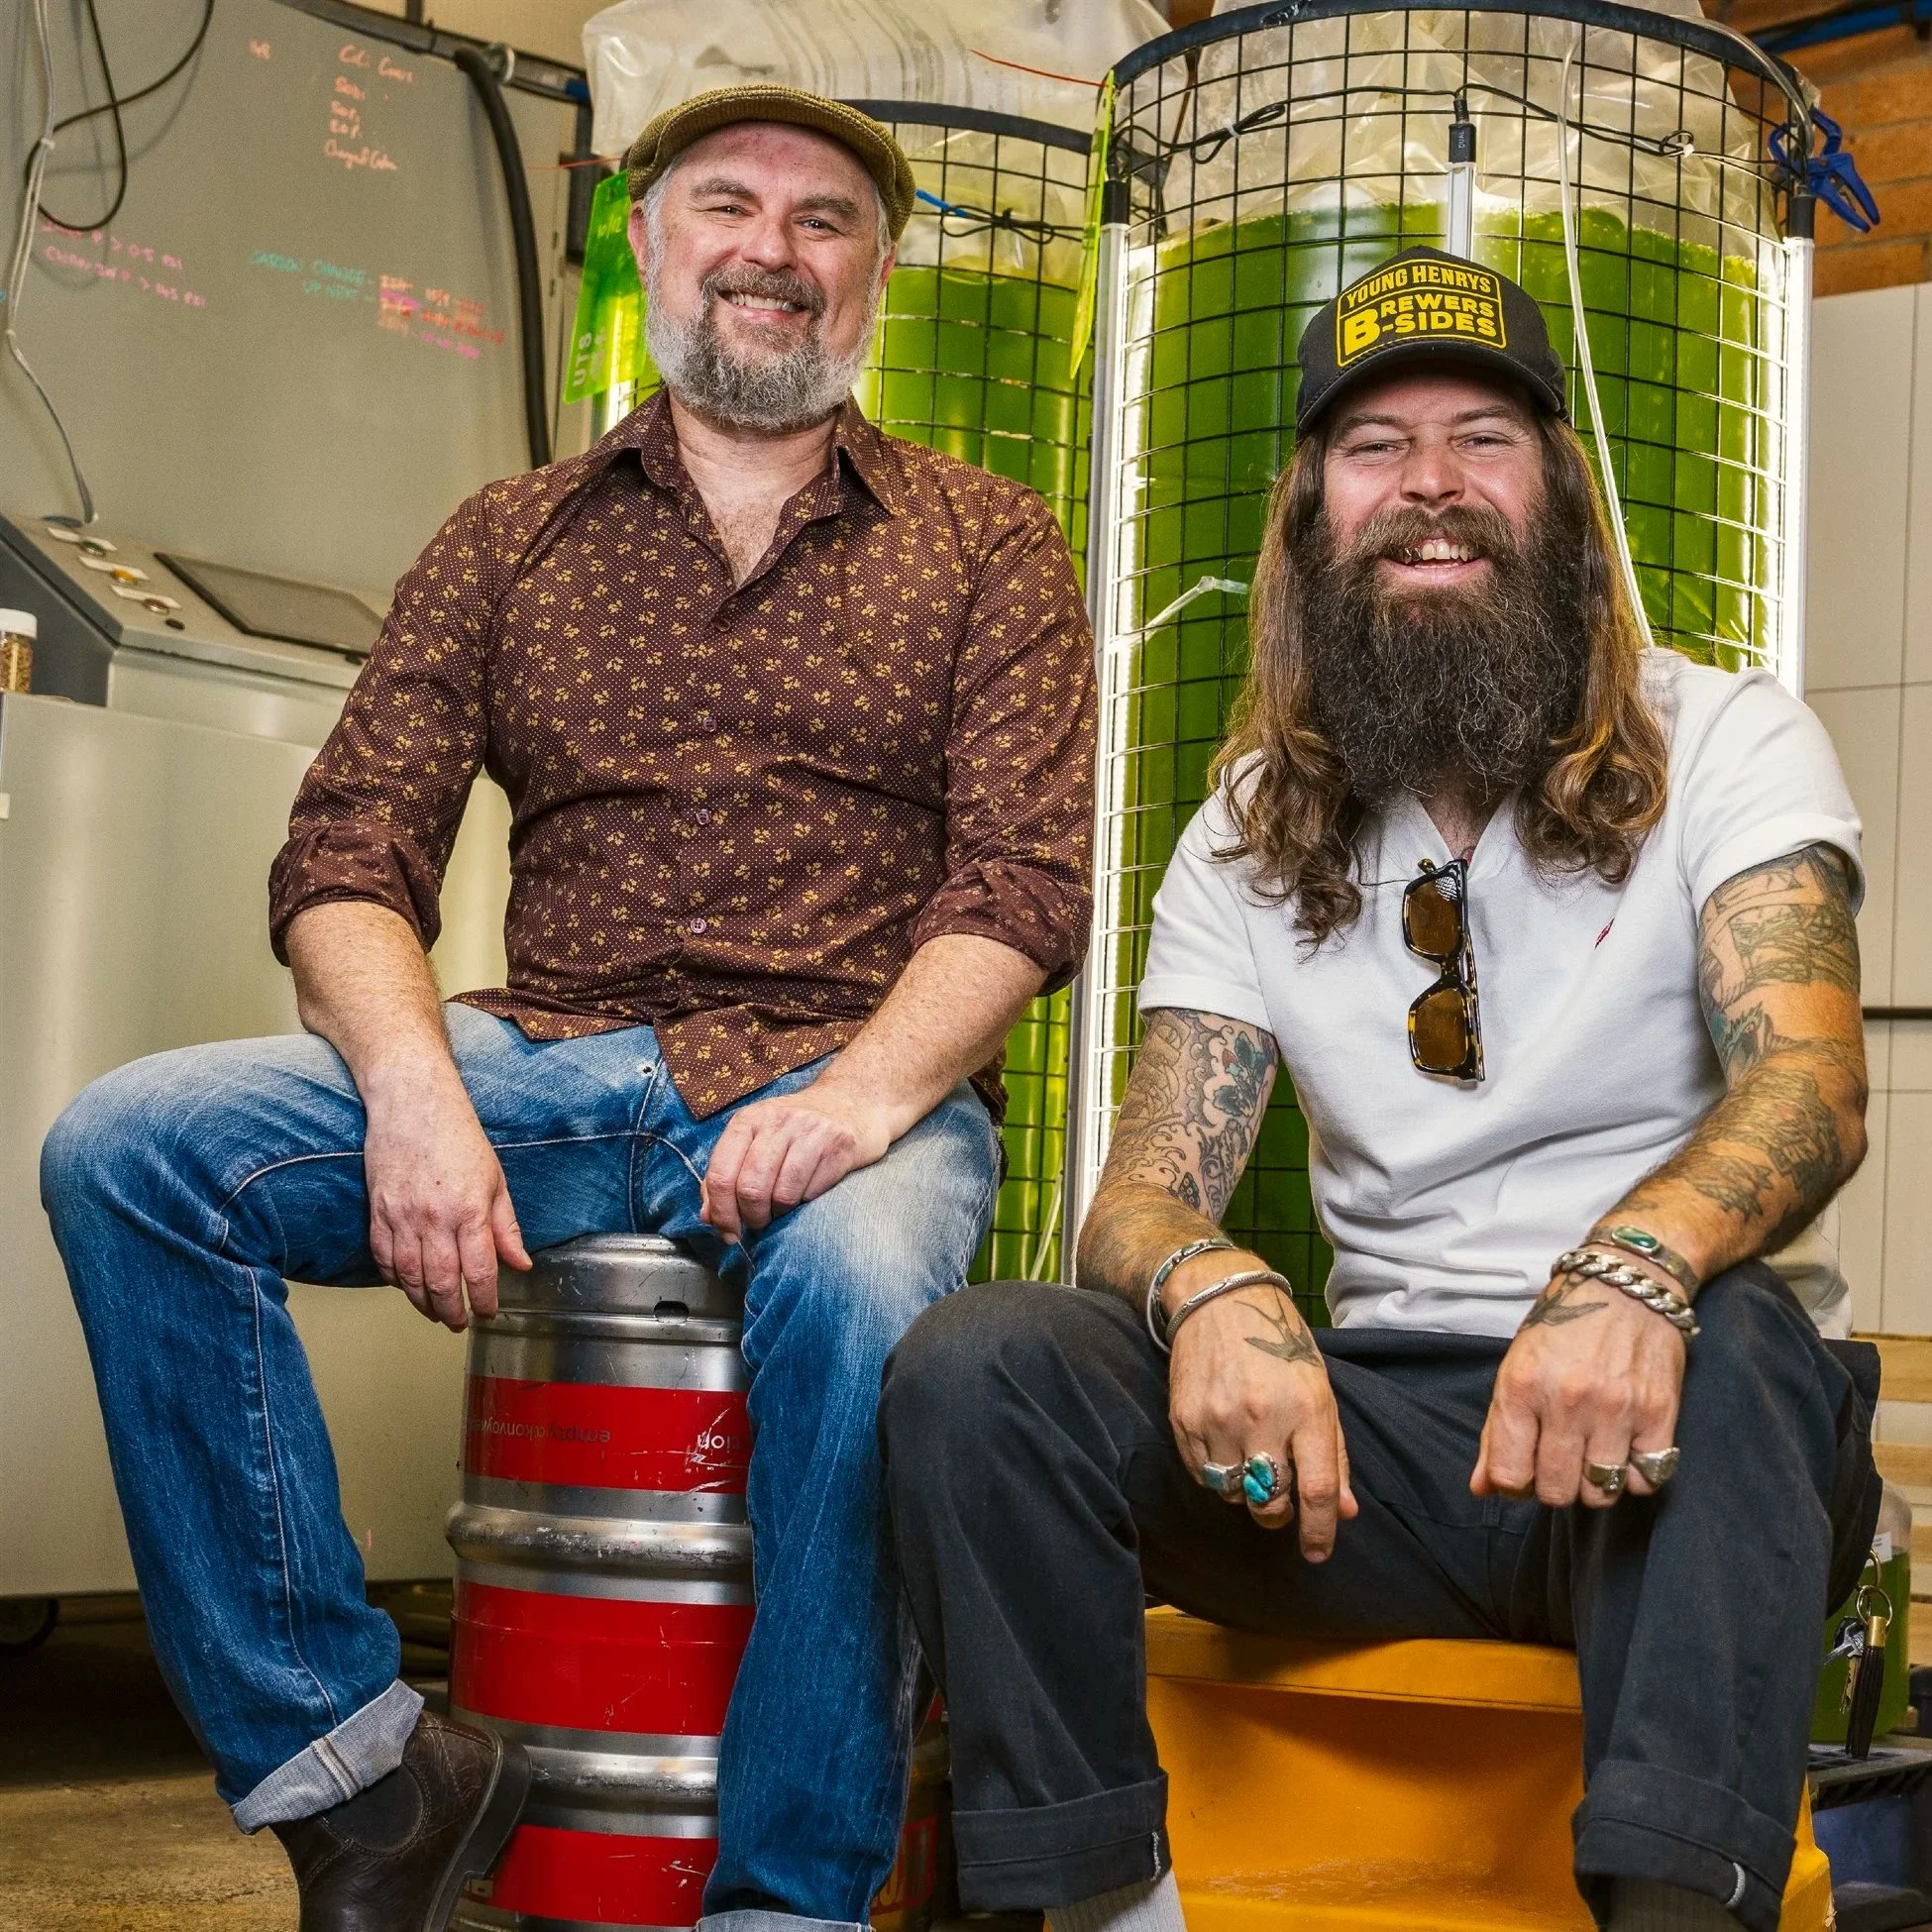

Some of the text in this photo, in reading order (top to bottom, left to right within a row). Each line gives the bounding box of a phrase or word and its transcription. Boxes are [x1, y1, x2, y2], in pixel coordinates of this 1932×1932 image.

[1346, 266, 1491, 308] YOUNG HENRYS
[1344, 308, 1496, 356] B-SIDES
[573, 332, 592, 387] UTS
